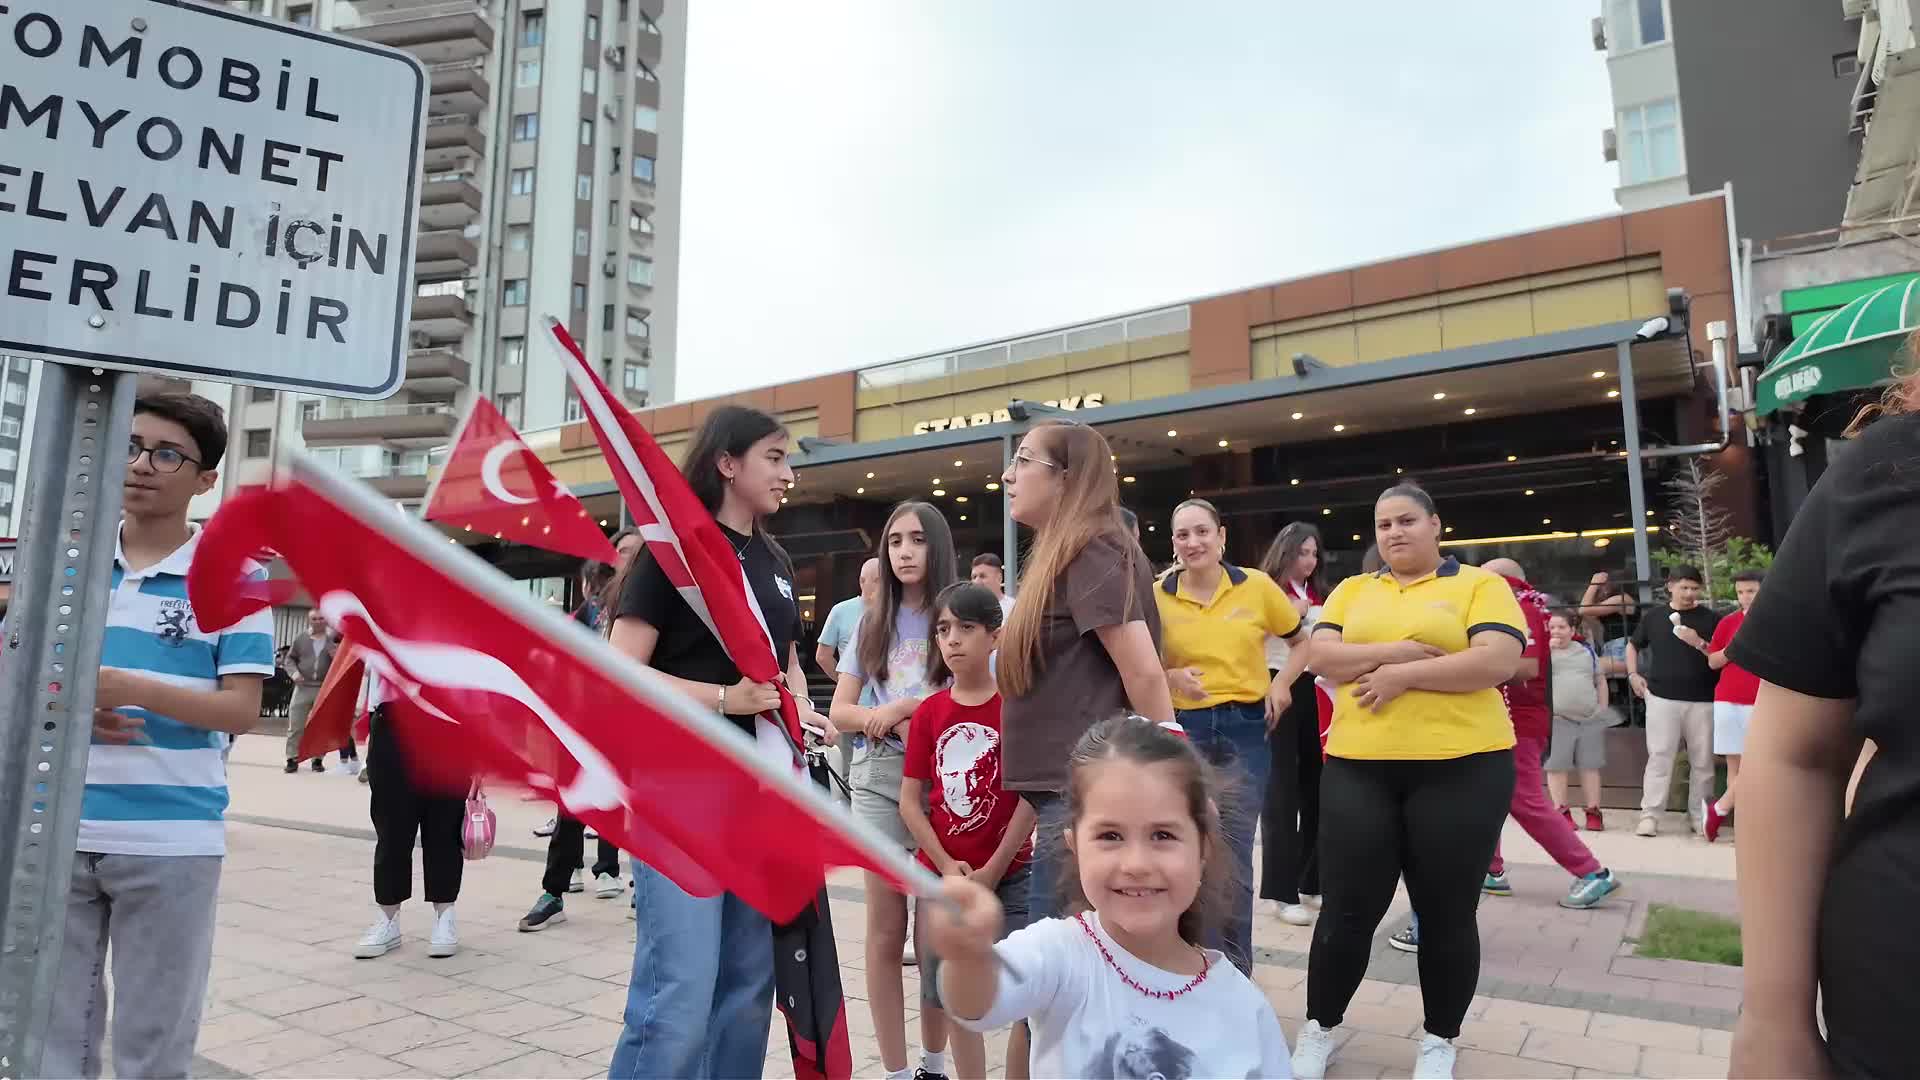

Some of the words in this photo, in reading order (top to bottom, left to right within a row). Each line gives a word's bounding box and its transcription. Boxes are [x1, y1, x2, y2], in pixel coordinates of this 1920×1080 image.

[0, 5, 339, 122] OMOBİL
[0, 85, 343, 191] MYONET
[265, 201, 388, 275] İÇİN
[8, 249, 349, 344] ERLİDİR
